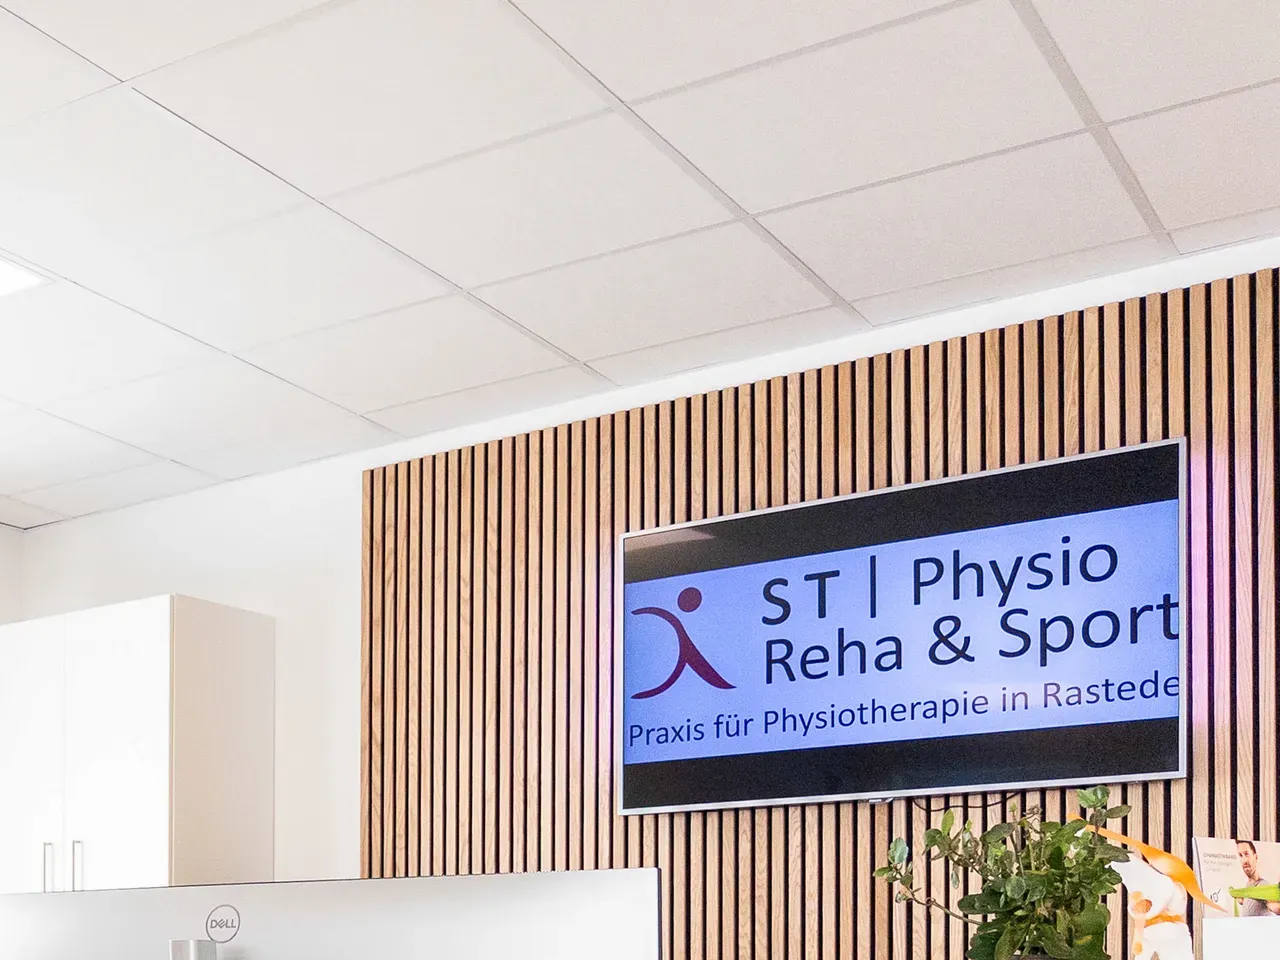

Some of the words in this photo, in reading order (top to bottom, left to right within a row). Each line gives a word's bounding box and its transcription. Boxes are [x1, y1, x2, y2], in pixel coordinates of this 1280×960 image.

[913, 535, 1118, 608] Physio
[765, 628, 903, 685] Reha
[928, 615, 975, 666] &
[998, 593, 1179, 668] Sport
[629, 718, 705, 748] Praxis
[713, 713, 754, 739] für
[764, 690, 989, 737] Physiotherapie
[1001, 686, 1029, 712] in
[1043, 669, 1179, 708] Rastede
[210, 918, 236, 929] DELL
